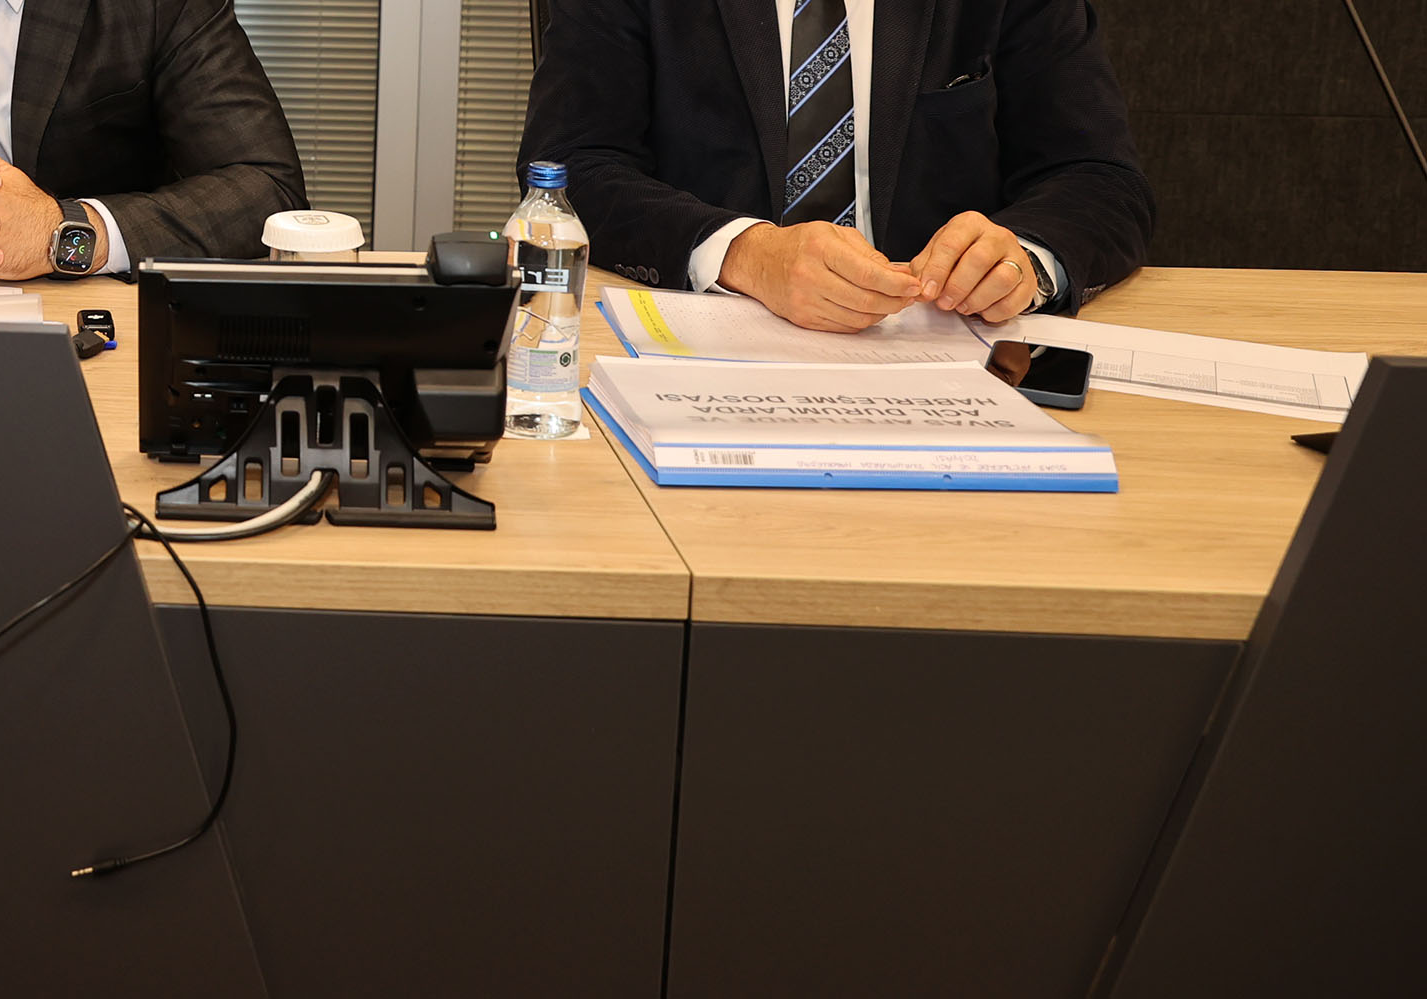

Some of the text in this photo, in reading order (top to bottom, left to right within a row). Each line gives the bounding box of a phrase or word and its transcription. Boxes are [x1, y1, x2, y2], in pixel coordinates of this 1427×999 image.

[654, 393, 998, 407] HABERLEŞME DOSYASI
[691, 406, 980, 418] ACİL DURUMLARDA
[686, 416, 725, 424] VE
